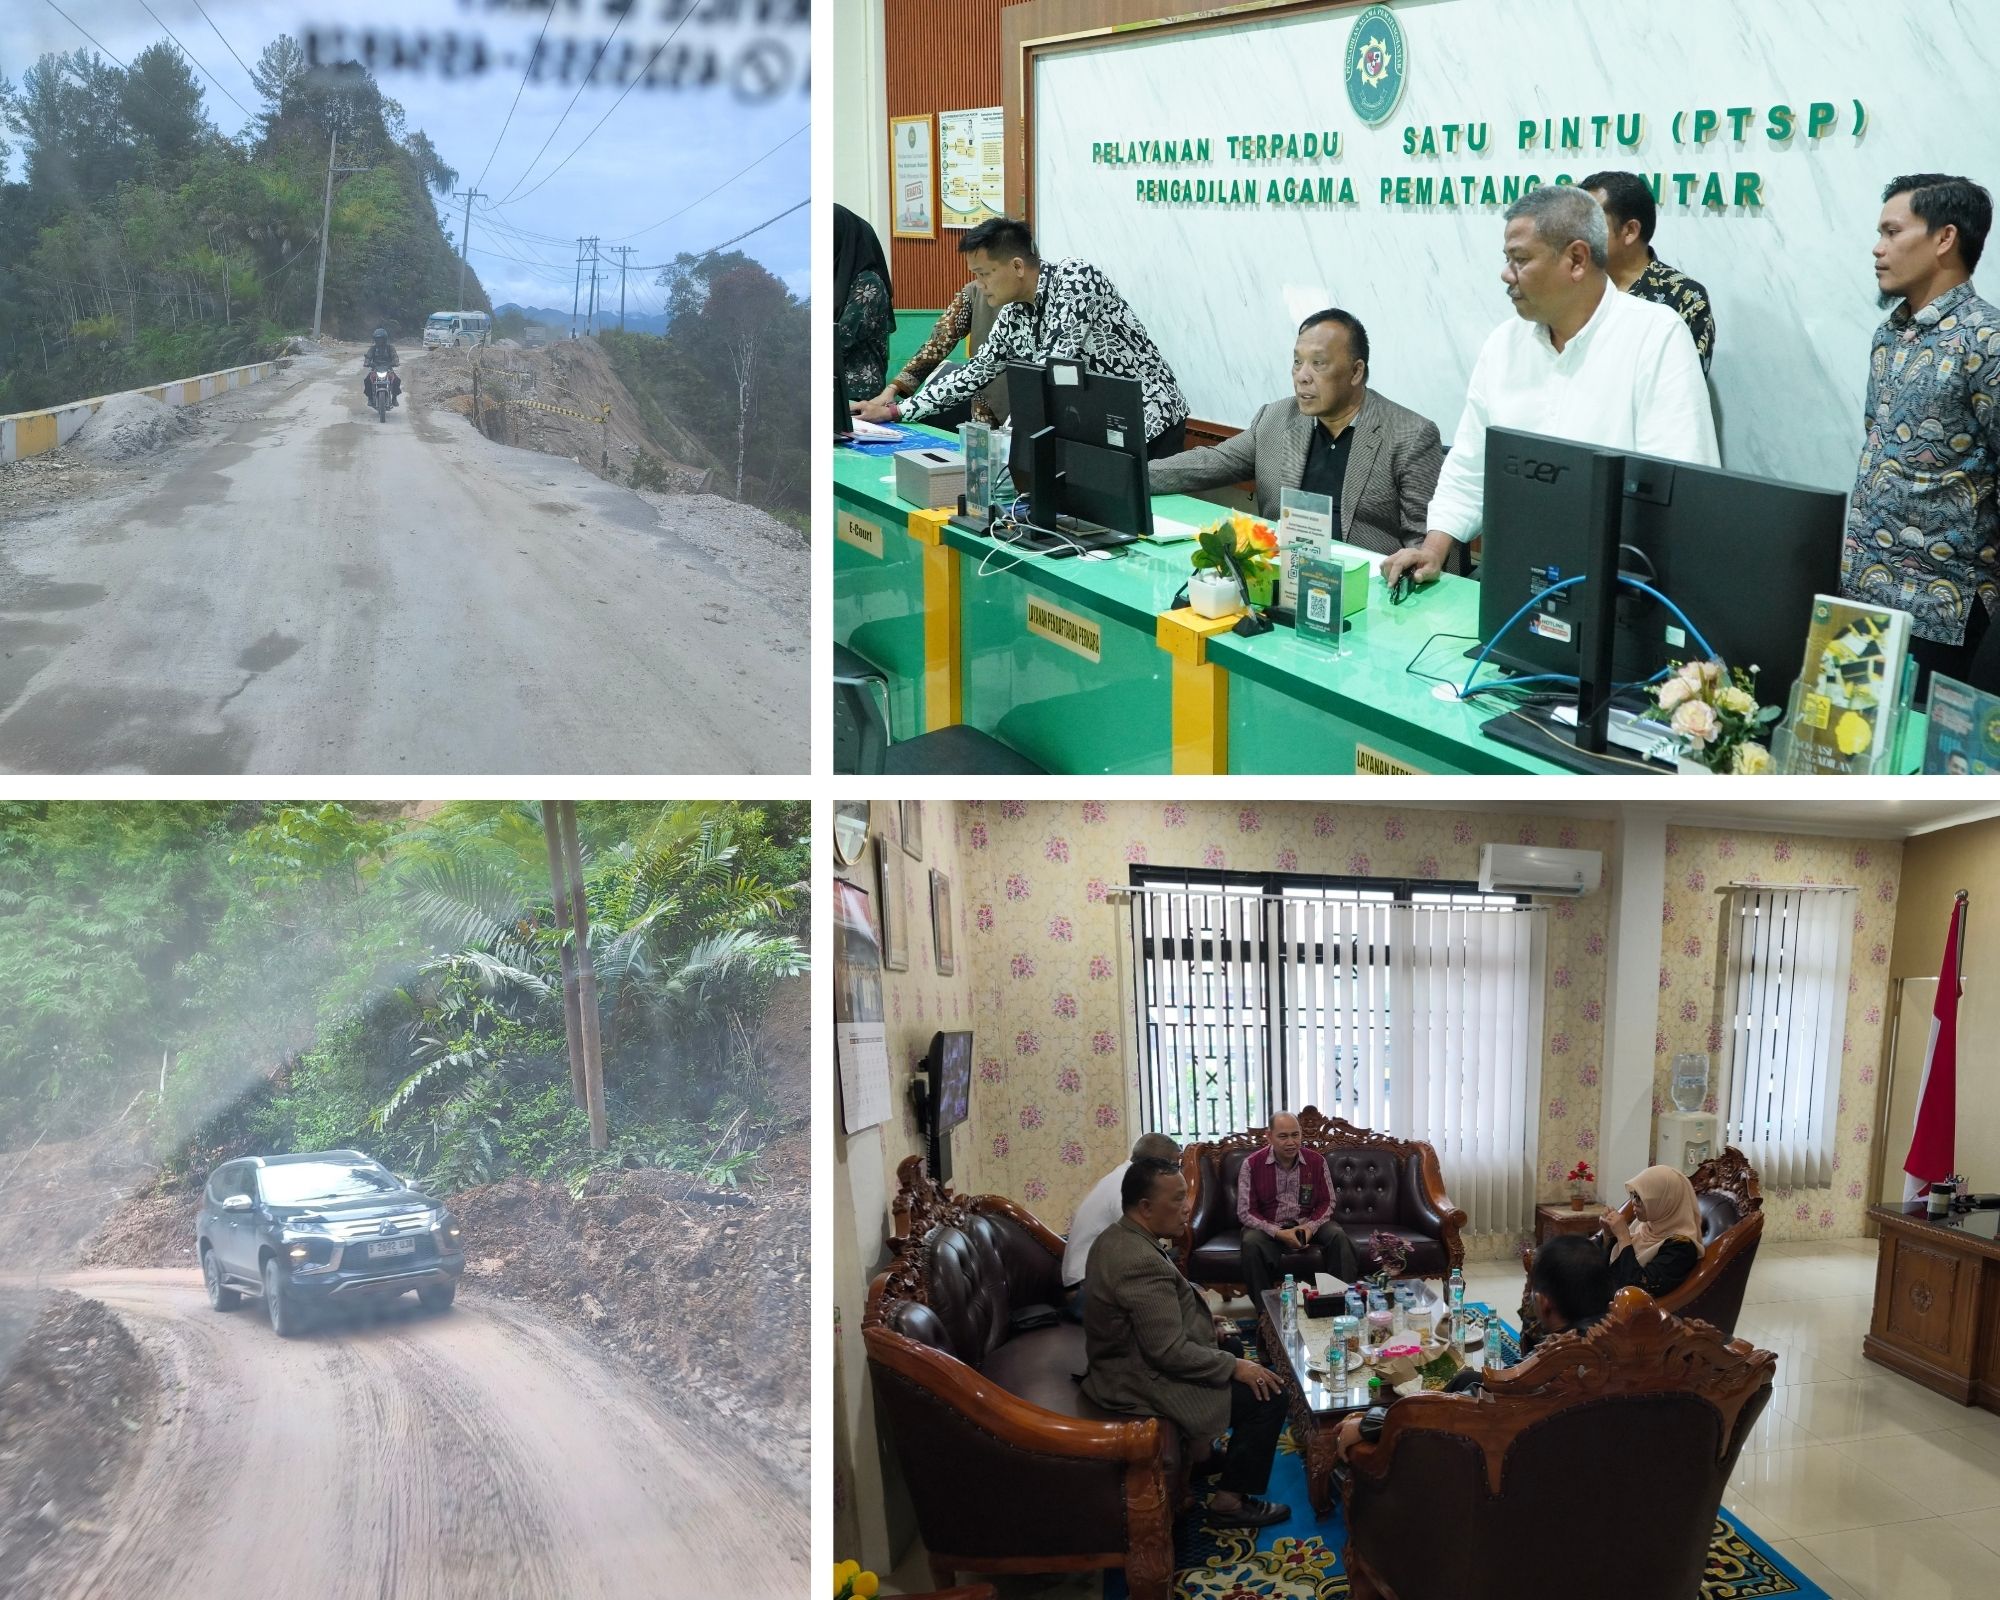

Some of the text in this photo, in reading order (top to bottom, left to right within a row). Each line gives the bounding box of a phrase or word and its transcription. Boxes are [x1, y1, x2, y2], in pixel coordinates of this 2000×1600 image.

[1092, 98, 1866, 164] PELAYANAN TERPADU SATU PINTU (PTSP)
[1136, 179, 1258, 204] PENGADILAN
[1266, 176, 1355, 204] AGAMA
[1503, 455, 1570, 485] acer
[849, 521, 873, 543] E-Court
[1028, 603, 1048, 630] LAYANAN
[1541, 619, 1565, 630] HOTLINE
[1357, 749, 1390, 775] LAYANAN
